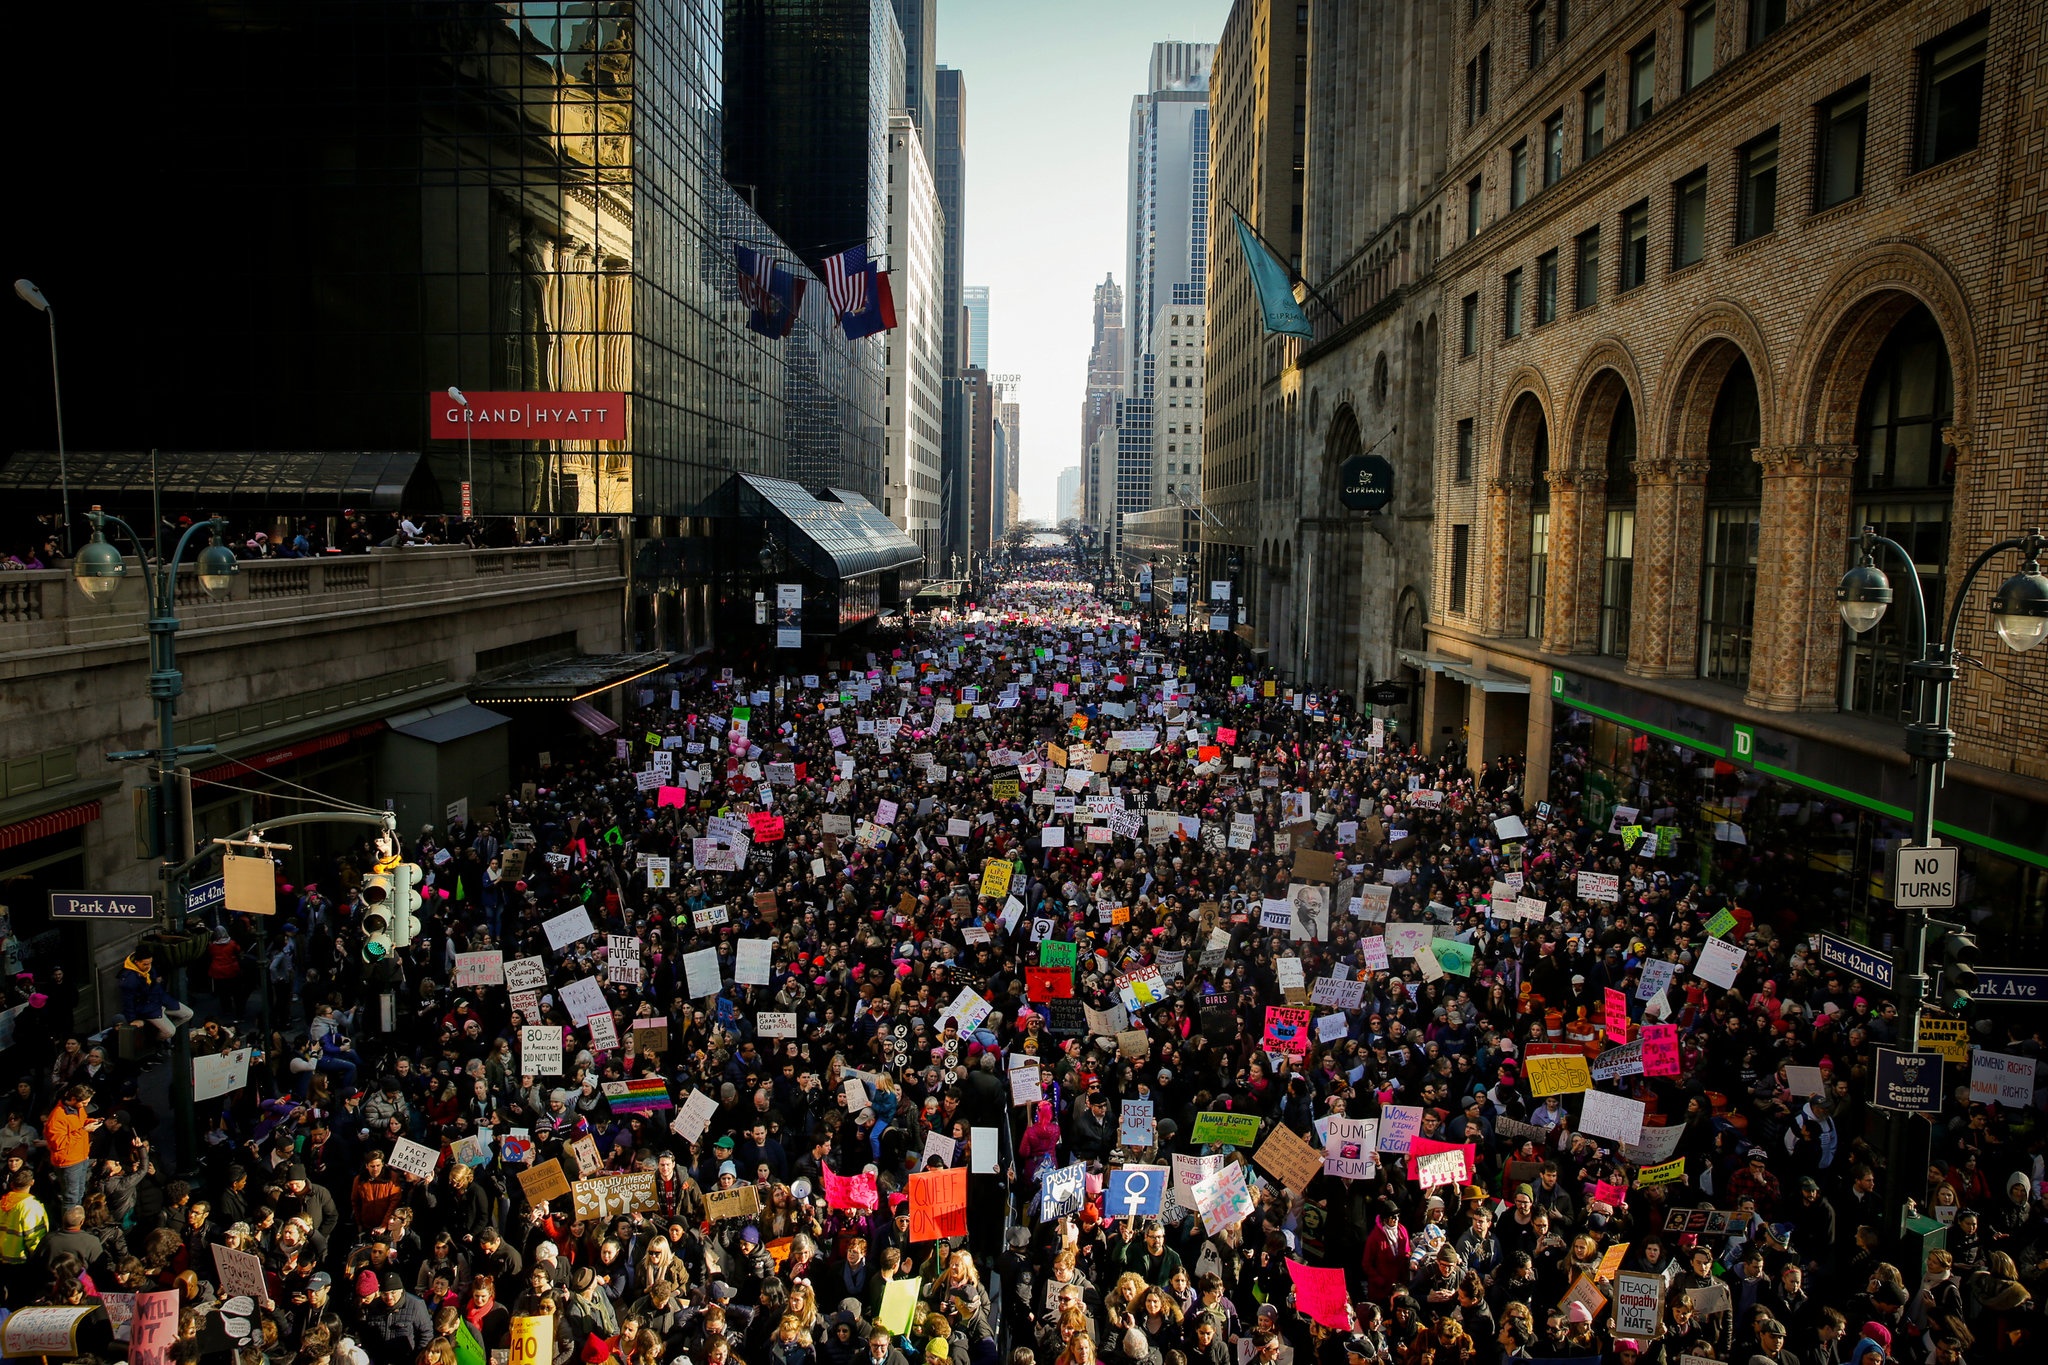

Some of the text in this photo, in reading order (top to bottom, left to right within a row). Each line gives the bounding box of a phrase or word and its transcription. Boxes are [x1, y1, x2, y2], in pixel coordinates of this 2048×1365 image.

[991, 374, 1021, 382] TUDOR
[446, 409, 608, 422] GRAND HYATT
[1346, 486, 1385, 494] CIPRIANI
[1553, 675, 1563, 693] TD
[1735, 730, 1751, 755] TD
[993, 770, 1019, 780] DECOLONIZE
[1133, 794, 1148, 802] THIS
[1412, 798, 1441, 808] ABOLITION
[1088, 830, 1111, 842] HOPE
[1914, 859, 1938, 874] NO
[987, 874, 1006, 882] PROTECT
[1598, 877, 1618, 887] TRUMP
[1585, 883, 1603, 892] EVIL
[1900, 882, 1951, 897] TURNS
[188, 892, 206, 908] East
[69, 899, 136, 914] Park Ave
[694, 908, 725, 923] RISE UP!
[613, 937, 634, 949] THE
[1056, 944, 1070, 952] WILL
[457, 955, 500, 965] WE MARCH
[609, 949, 639, 960] FUTURE
[1046, 956, 1070, 964] ERASED
[479, 964, 486, 972] U
[1646, 958, 1656, 967] MY
[1824, 942, 1889, 983] East 42nd St
[507, 964, 519, 976] STOP
[610, 967, 639, 983] FEMALE
[478, 973, 500, 982] PEOPLE
[511, 977, 545, 987] ROE WADE
[1318, 977, 1362, 989] DANCING
[1315, 986, 1357, 998] WITH THE
[1971, 979, 2037, 996] rk Ave
[512, 994, 535, 1002] RESPECT
[1205, 996, 1228, 1005] GIRLS
[1320, 996, 1354, 1007] TSARS
[1271, 1008, 1305, 1020] TWEETS
[590, 1016, 611, 1026] GIRLS
[1919, 1020, 1965, 1030] ANSANS
[1642, 1028, 1672, 1040] GIRL
[596, 1041, 617, 1049] RIGHTS
[1266, 1039, 1298, 1048] RESPECT
[524, 1053, 560, 1062] DID NOT VOTE
[1594, 1055, 1643, 1070] RESISTANCE
[1896, 1056, 1926, 1066] NYPD
[536, 1064, 557, 1073] TRUMP
[1604, 1063, 1633, 1074] FEMINISM
[2006, 1061, 2032, 1076] RIGHTS
[1888, 1082, 1930, 1095] Security
[1971, 1080, 2028, 1099] HUMAN RIGHTS
[1888, 1092, 1929, 1103] Camera
[1123, 1104, 1151, 1117] RISE
[1128, 1118, 1145, 1129] UP!
[1201, 1115, 1253, 1125] HUMAN RIGHTS
[1330, 1121, 1374, 1139] DUMP
[929, 1133, 952, 1146] ONE
[1380, 1139, 1411, 1151] RIGHT
[405, 1145, 427, 1158] FACT
[398, 1152, 427, 1168] BASED
[1176, 1155, 1222, 1166] NEVER DOUBT
[391, 1159, 428, 1178] REALITY
[1326, 1158, 1373, 1175] TRUMP
[1641, 1162, 1681, 1175] EQUALITY
[1046, 1163, 1085, 1193] PUSSIES
[1653, 1172, 1669, 1180] FOR
[611, 1182, 651, 1194] INCLUSION
[1043, 1188, 1085, 1220] HAVE CLAWS
[1212, 1194, 1247, 1222] HER
[913, 1203, 966, 1234] ON HIM
[223, 1252, 254, 1270] MARCH
[222, 1263, 255, 1284] FORWARD
[1585, 1283, 1597, 1295] THE
[1620, 1281, 1657, 1295] TEACH
[1575, 1286, 1595, 1309] FUTURE
[1620, 1294, 1657, 1310] empathy
[136, 1296, 173, 1320] WILL
[1621, 1306, 1645, 1318] NOT
[1624, 1317, 1652, 1330] HATE
[25, 1332, 68, 1345] WHEELS
